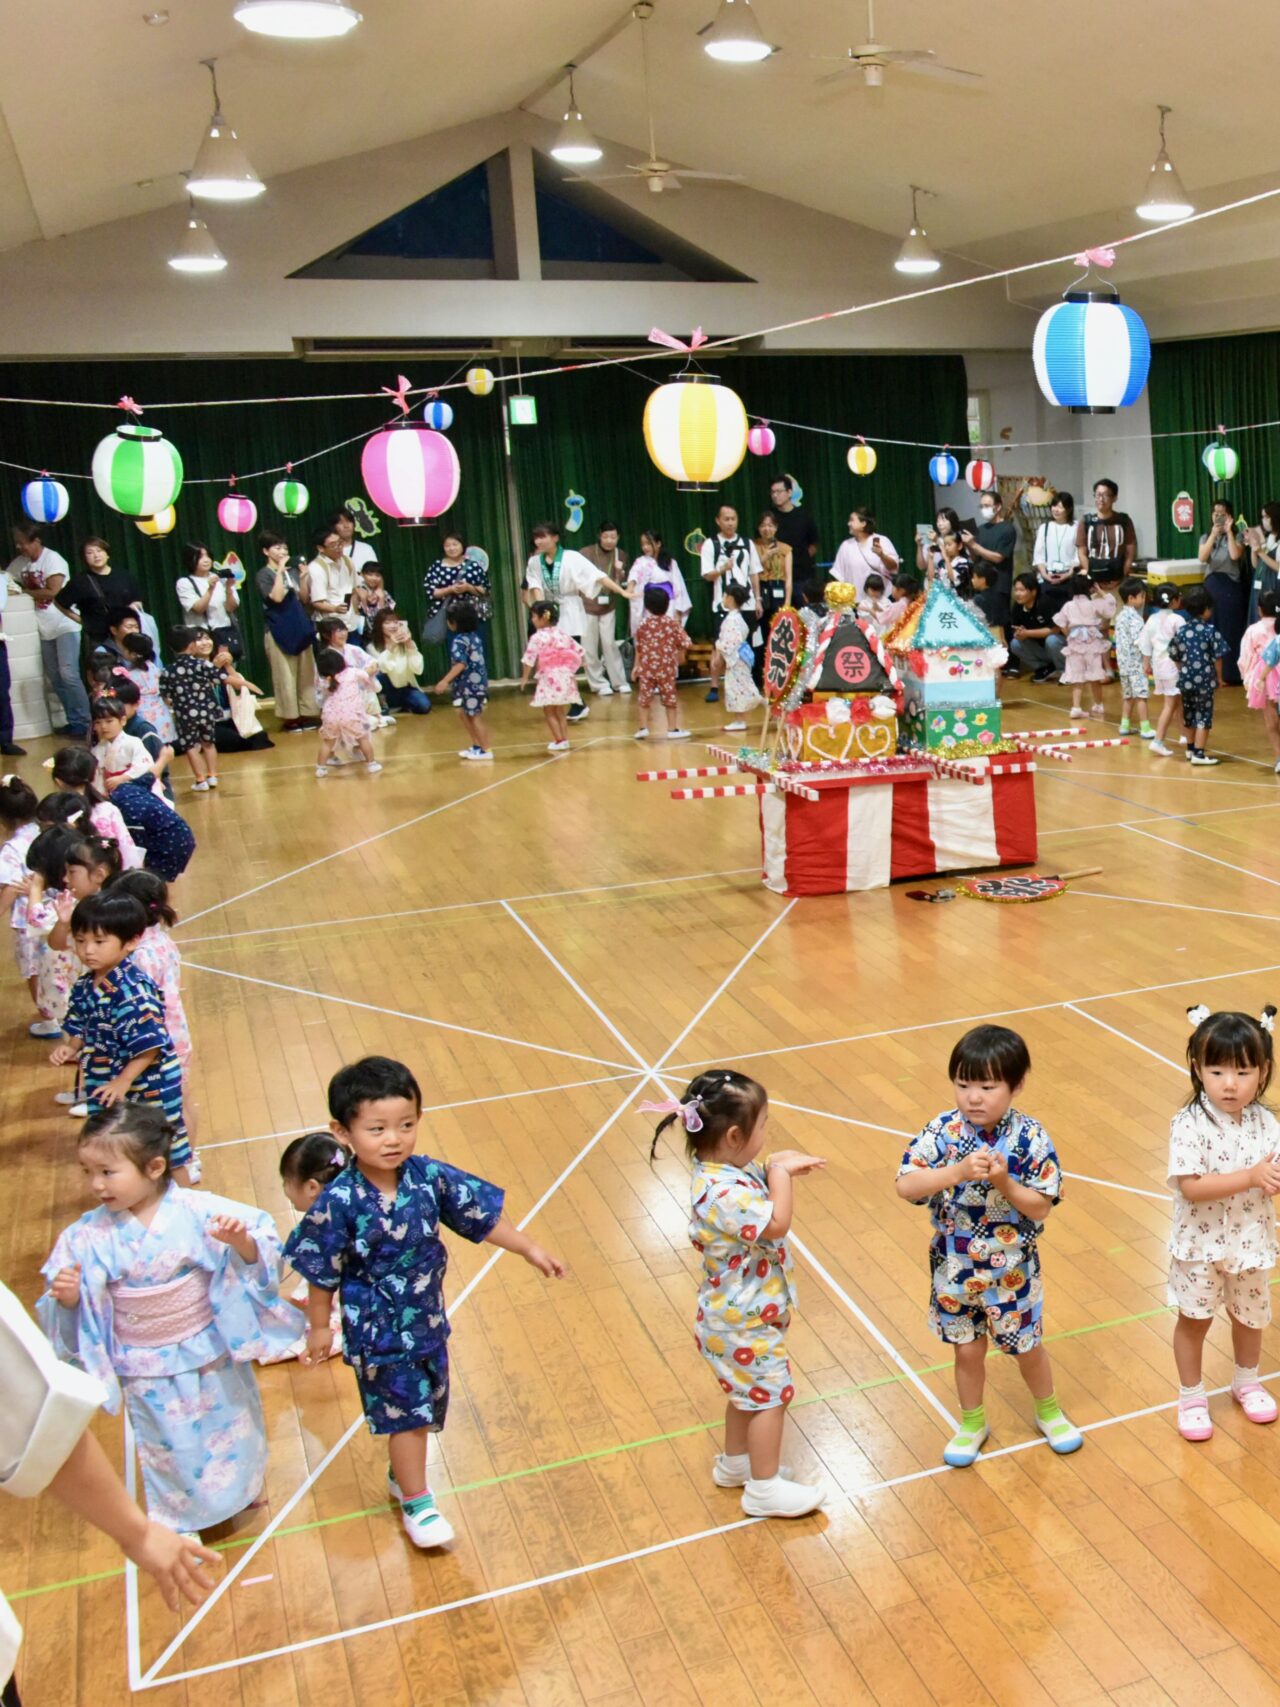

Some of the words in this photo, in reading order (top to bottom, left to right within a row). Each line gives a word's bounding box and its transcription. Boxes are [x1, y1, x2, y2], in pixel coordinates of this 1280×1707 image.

[938, 612, 959, 629] 祭
[769, 616, 797, 691] 祭
[841, 651, 865, 678] 祭
